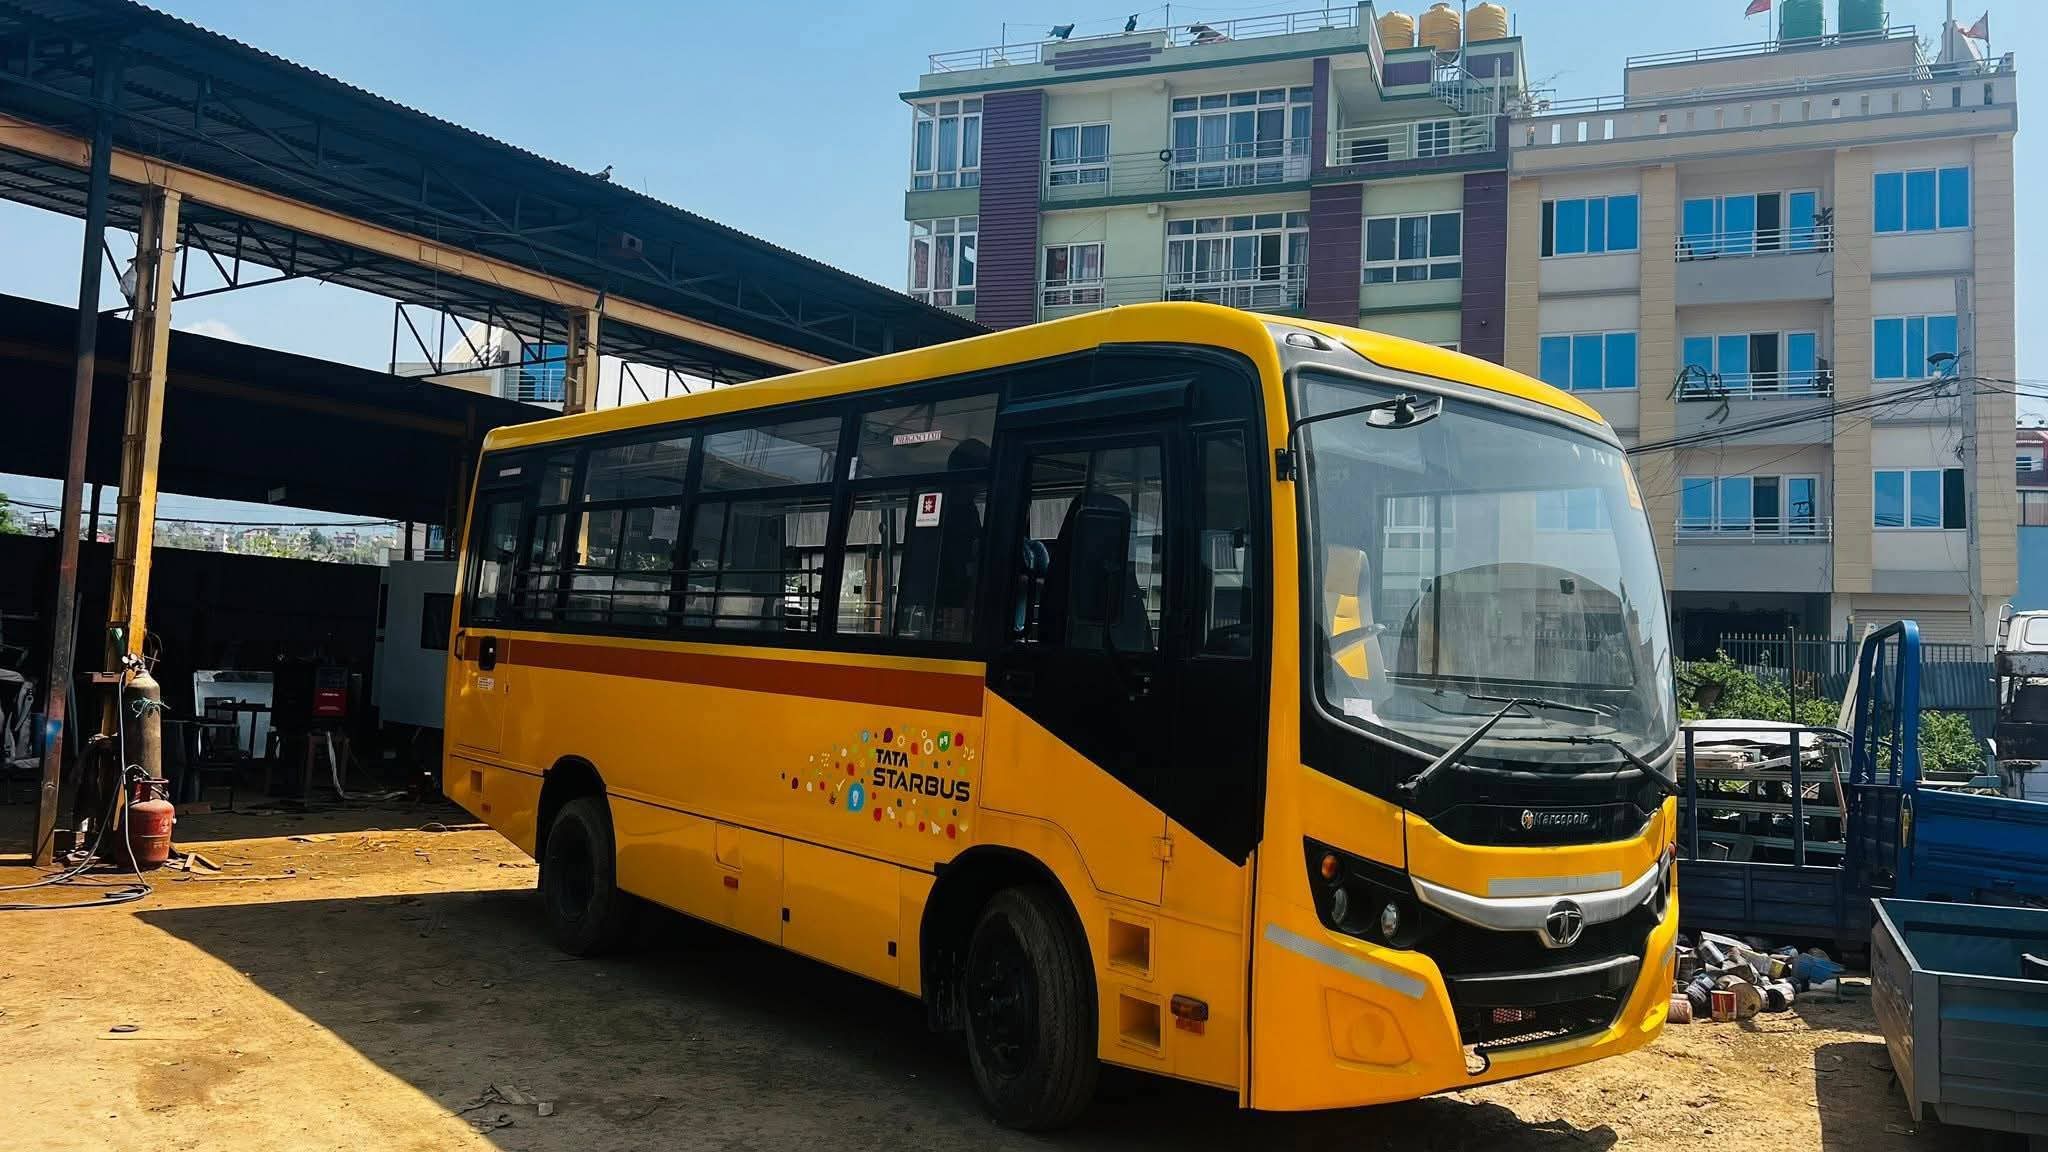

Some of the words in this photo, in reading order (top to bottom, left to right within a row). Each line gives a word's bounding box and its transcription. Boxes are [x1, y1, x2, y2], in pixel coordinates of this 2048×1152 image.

[875, 748, 909, 768] TATA
[872, 767, 970, 802] STARBUS
[1533, 812, 1589, 826] Marcopolo
